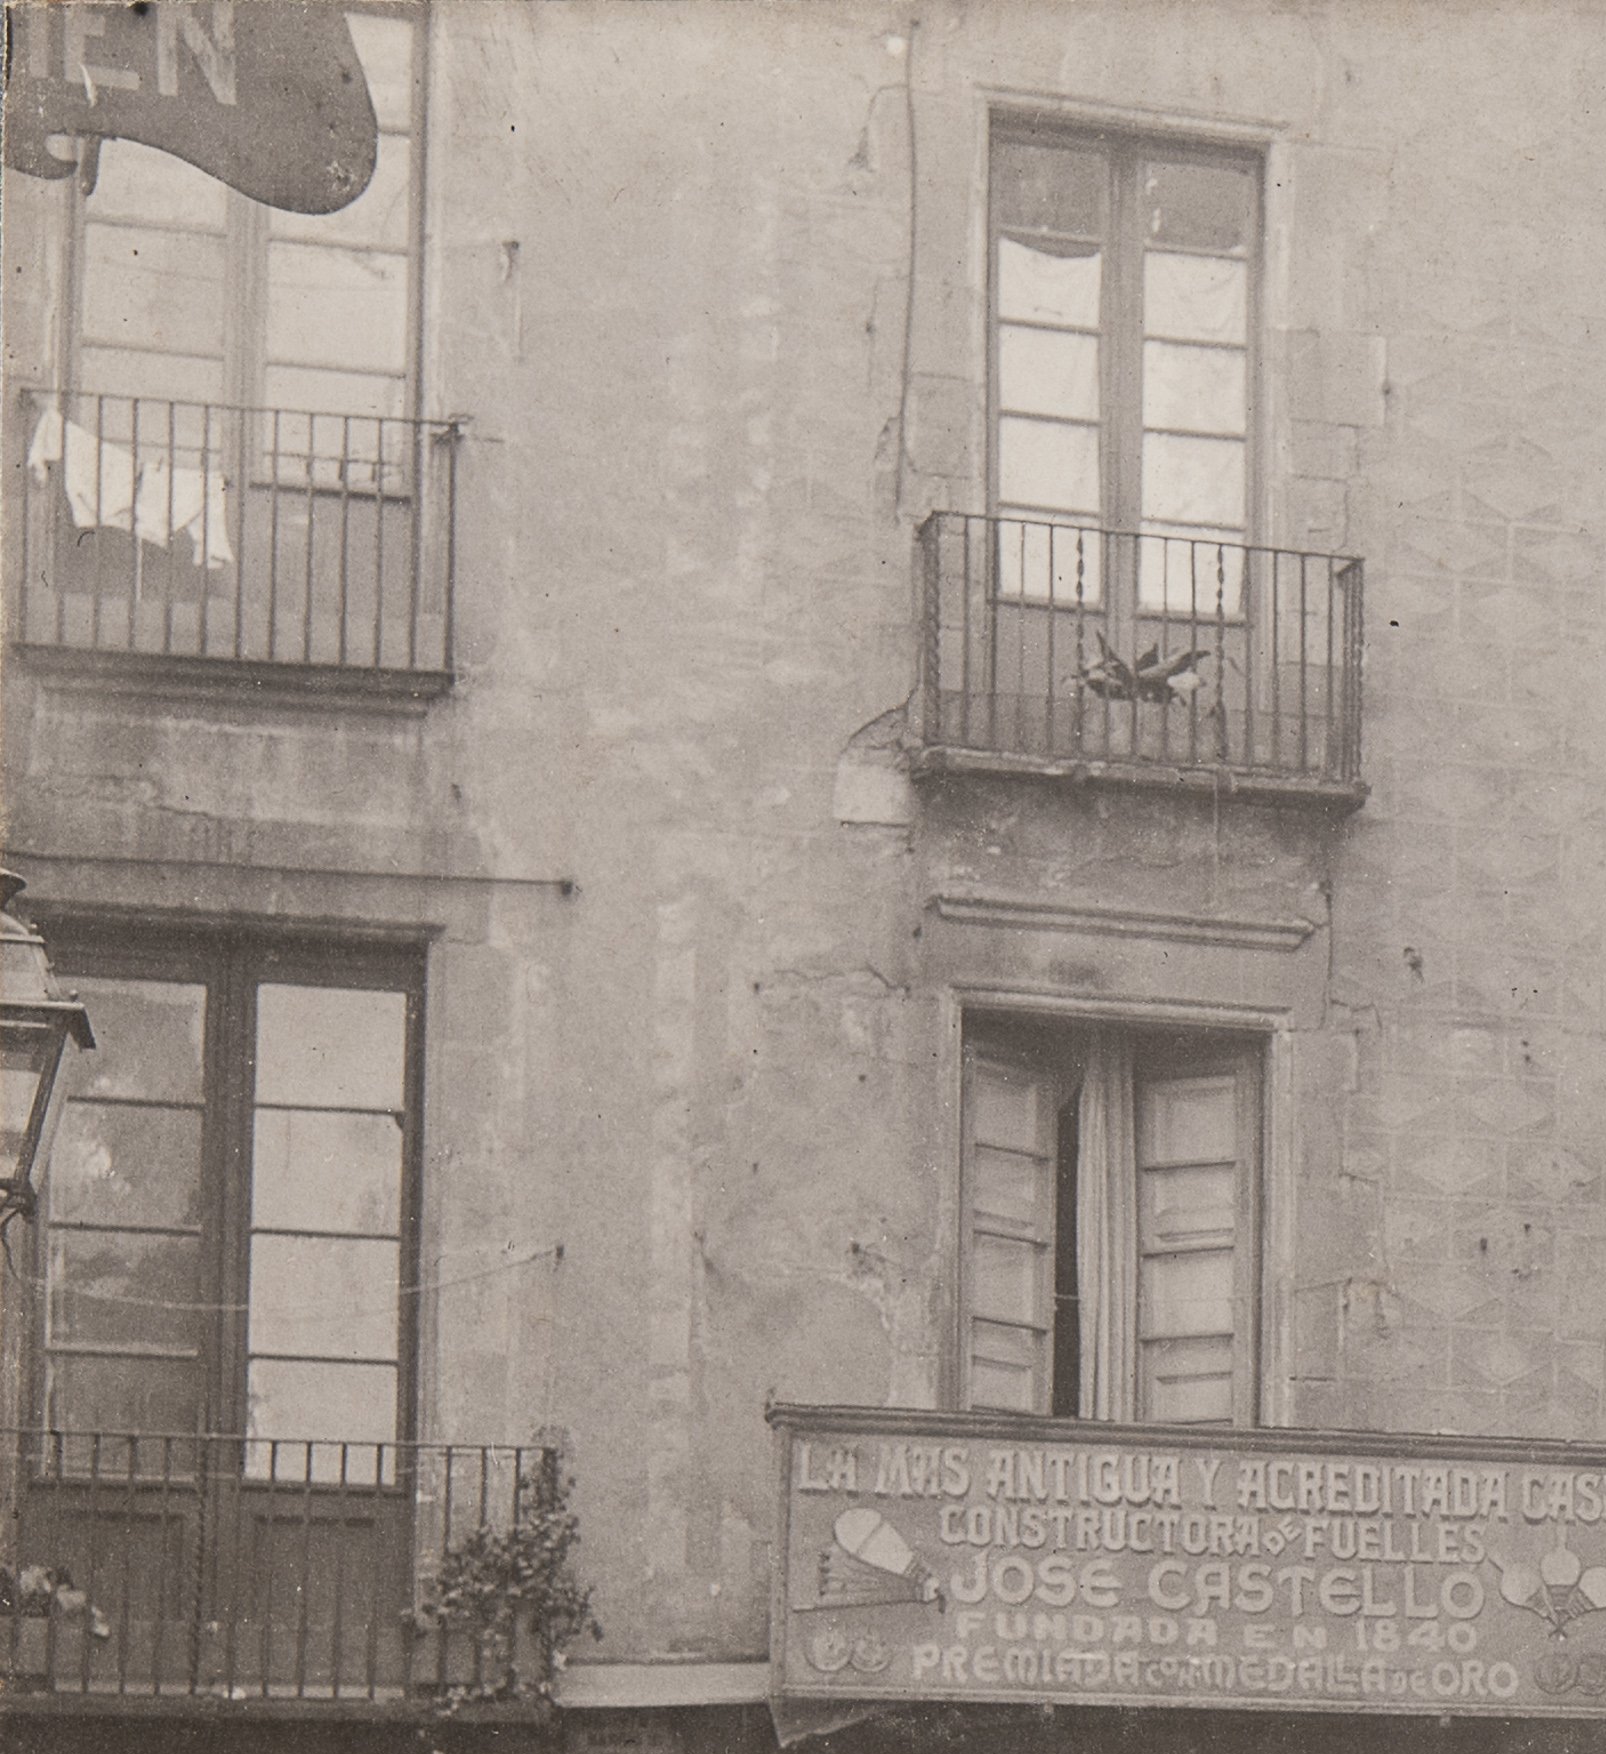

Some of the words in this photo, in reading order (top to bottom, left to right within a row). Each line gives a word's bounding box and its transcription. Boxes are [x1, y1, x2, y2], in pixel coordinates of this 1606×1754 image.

[800, 1443, 858, 1497] LA
[875, 1446, 972, 1498] MAS
[987, 1447, 1183, 1508] ANTIGUA
[1194, 1457, 1221, 1511] Y
[1237, 1458, 1510, 1520] ACREDITADA
[940, 1503, 1260, 1557] CONSTRUCTORA
[1262, 1513, 1300, 1556] DE
[1303, 1517, 1488, 1565] FUELLES
[955, 1611, 1218, 1647] FUNDADA
[1243, 1623, 1328, 1649] EN
[1355, 1620, 1478, 1653] 1840
[911, 1641, 1142, 1687] PREMIADA
[1200, 1654, 1388, 1694] MEDALLA
[1431, 1659, 1520, 1698] ORO
